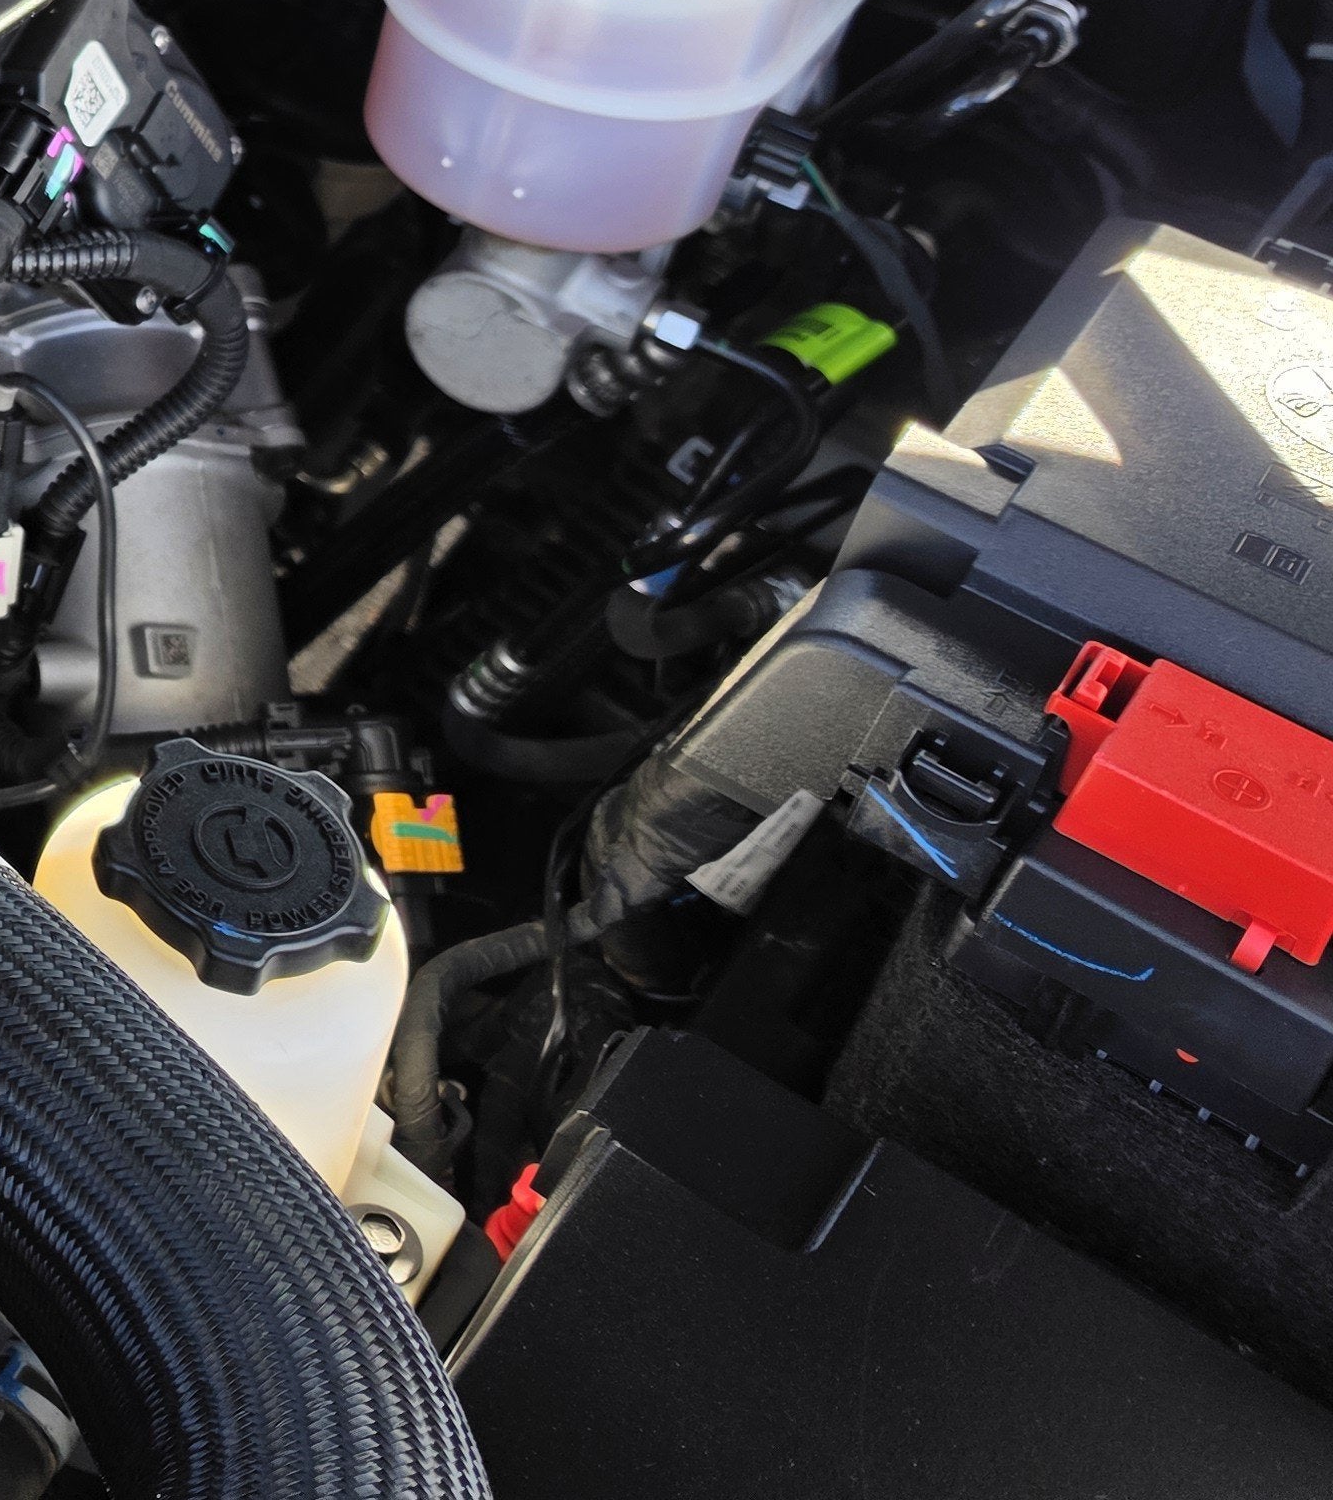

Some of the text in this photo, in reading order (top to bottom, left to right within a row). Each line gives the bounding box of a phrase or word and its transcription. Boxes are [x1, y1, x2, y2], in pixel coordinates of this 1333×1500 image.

[142, 770, 226, 918] USE APPROVED
[247, 890, 340, 929] POWER
